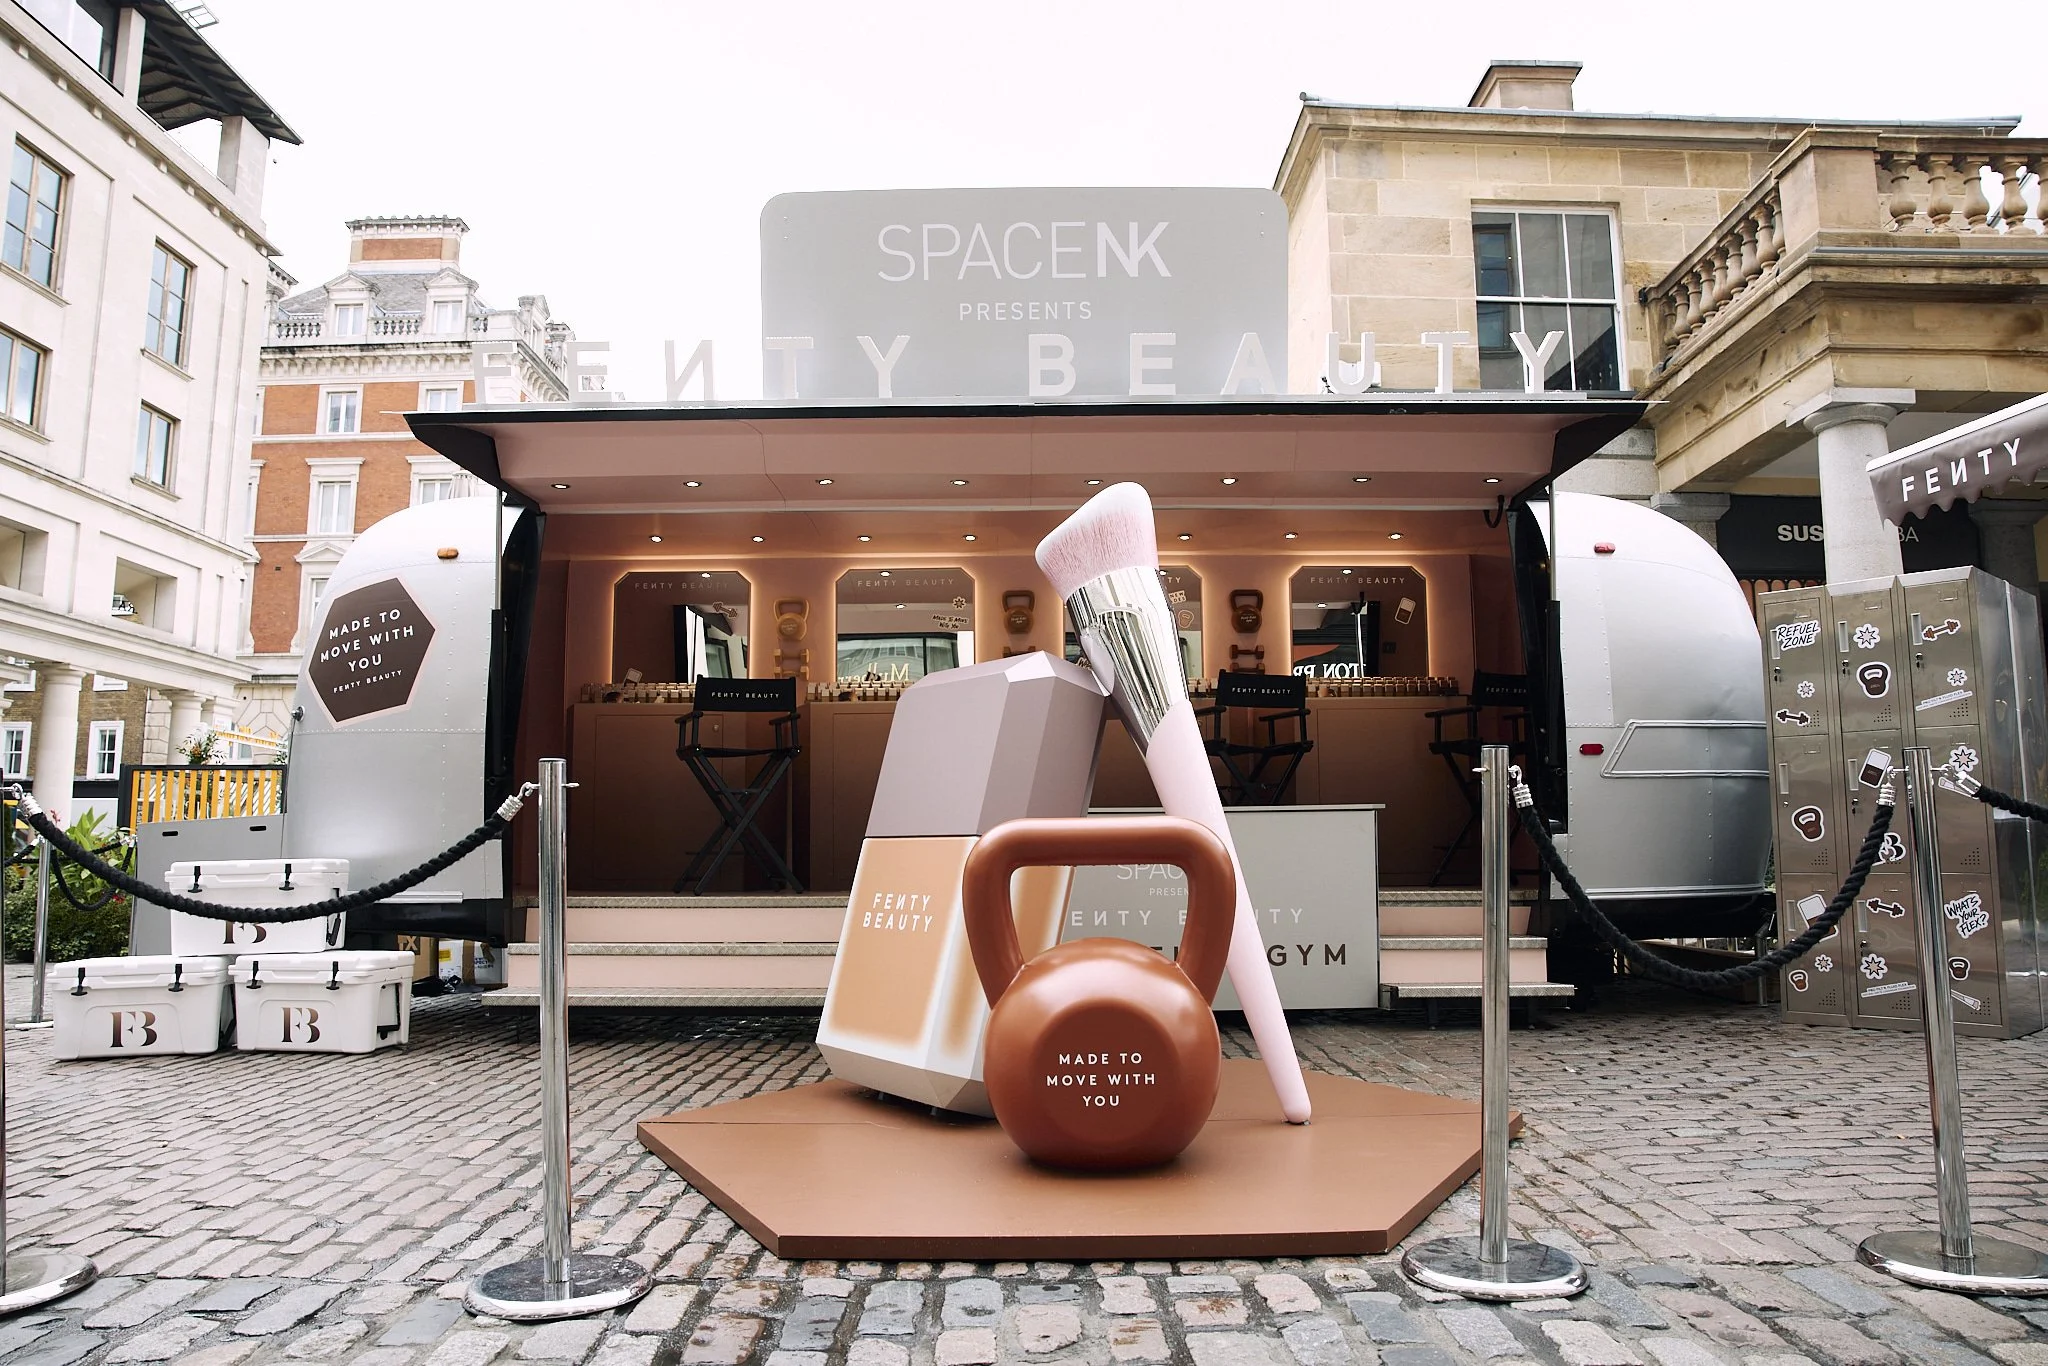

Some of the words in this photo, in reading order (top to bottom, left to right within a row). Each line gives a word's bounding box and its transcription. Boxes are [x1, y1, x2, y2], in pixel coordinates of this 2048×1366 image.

[959, 301, 1092, 321] PRESENTS
[1028, 331, 1565, 397] BEAUTY
[1357, 577, 1406, 585] BEAUTY
[329, 616, 372, 640] MADE
[379, 608, 401, 624] TO
[1777, 622, 1819, 640] REFUEL
[320, 639, 361, 663] MOVE
[369, 625, 415, 646] WITH
[1783, 633, 1814, 649] ZONE
[348, 653, 383, 673] YOU
[366, 669, 403, 684] BEAUTY
[863, 911, 934, 933] BEAUTY
[1959, 907, 1980, 923] YOUR
[1960, 913, 1987, 936] FLEX?
[1266, 943, 1347, 967] GYM
[1058, 1053, 1110, 1066] MADE
[1119, 1052, 1143, 1065] TO
[1046, 1074, 1098, 1087] MOVE
[1107, 1072, 1156, 1086] WITH
[1082, 1094, 1121, 1107] YOU
